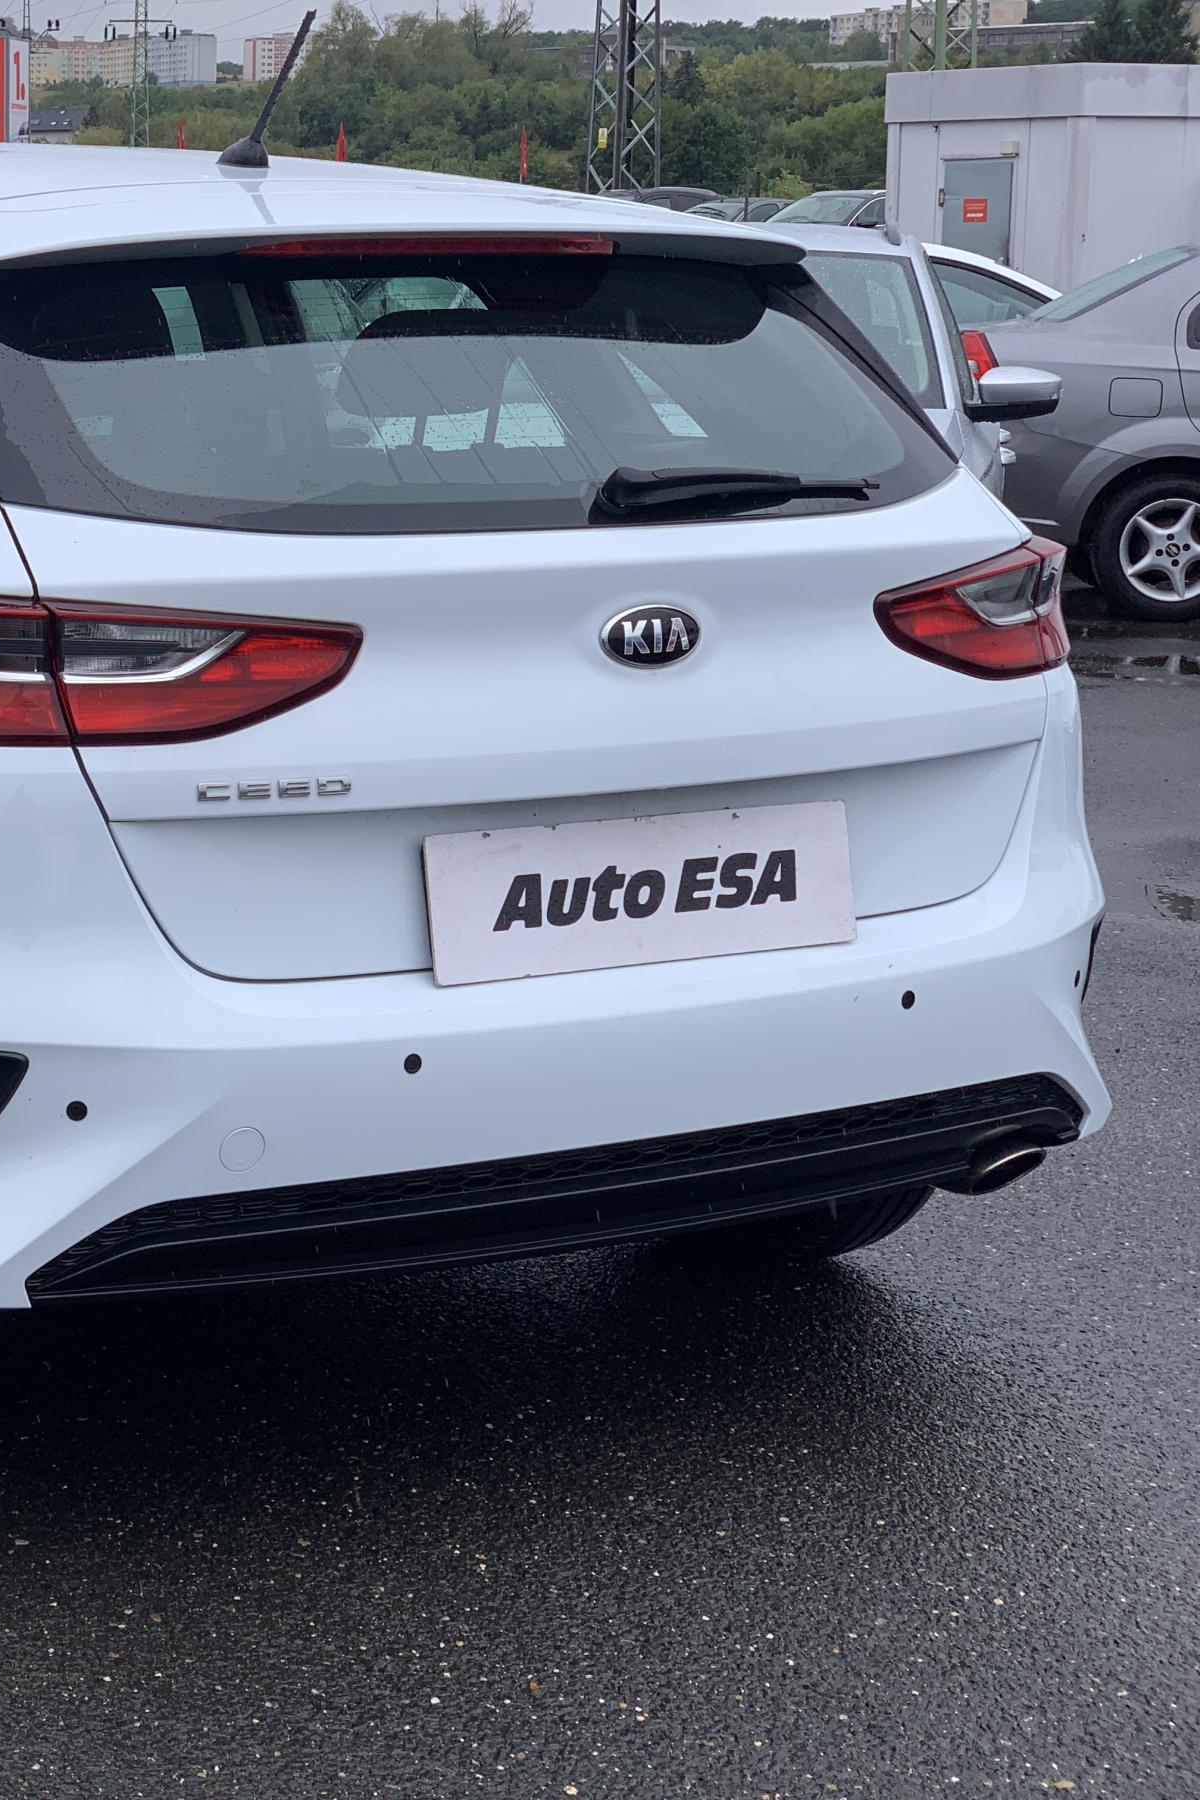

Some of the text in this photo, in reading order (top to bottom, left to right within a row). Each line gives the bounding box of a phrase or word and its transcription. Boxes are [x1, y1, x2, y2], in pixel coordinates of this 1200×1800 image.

[621, 617, 690, 655] KIA
[197, 775, 353, 801] CEED
[492, 849, 798, 932] Auto ESA
